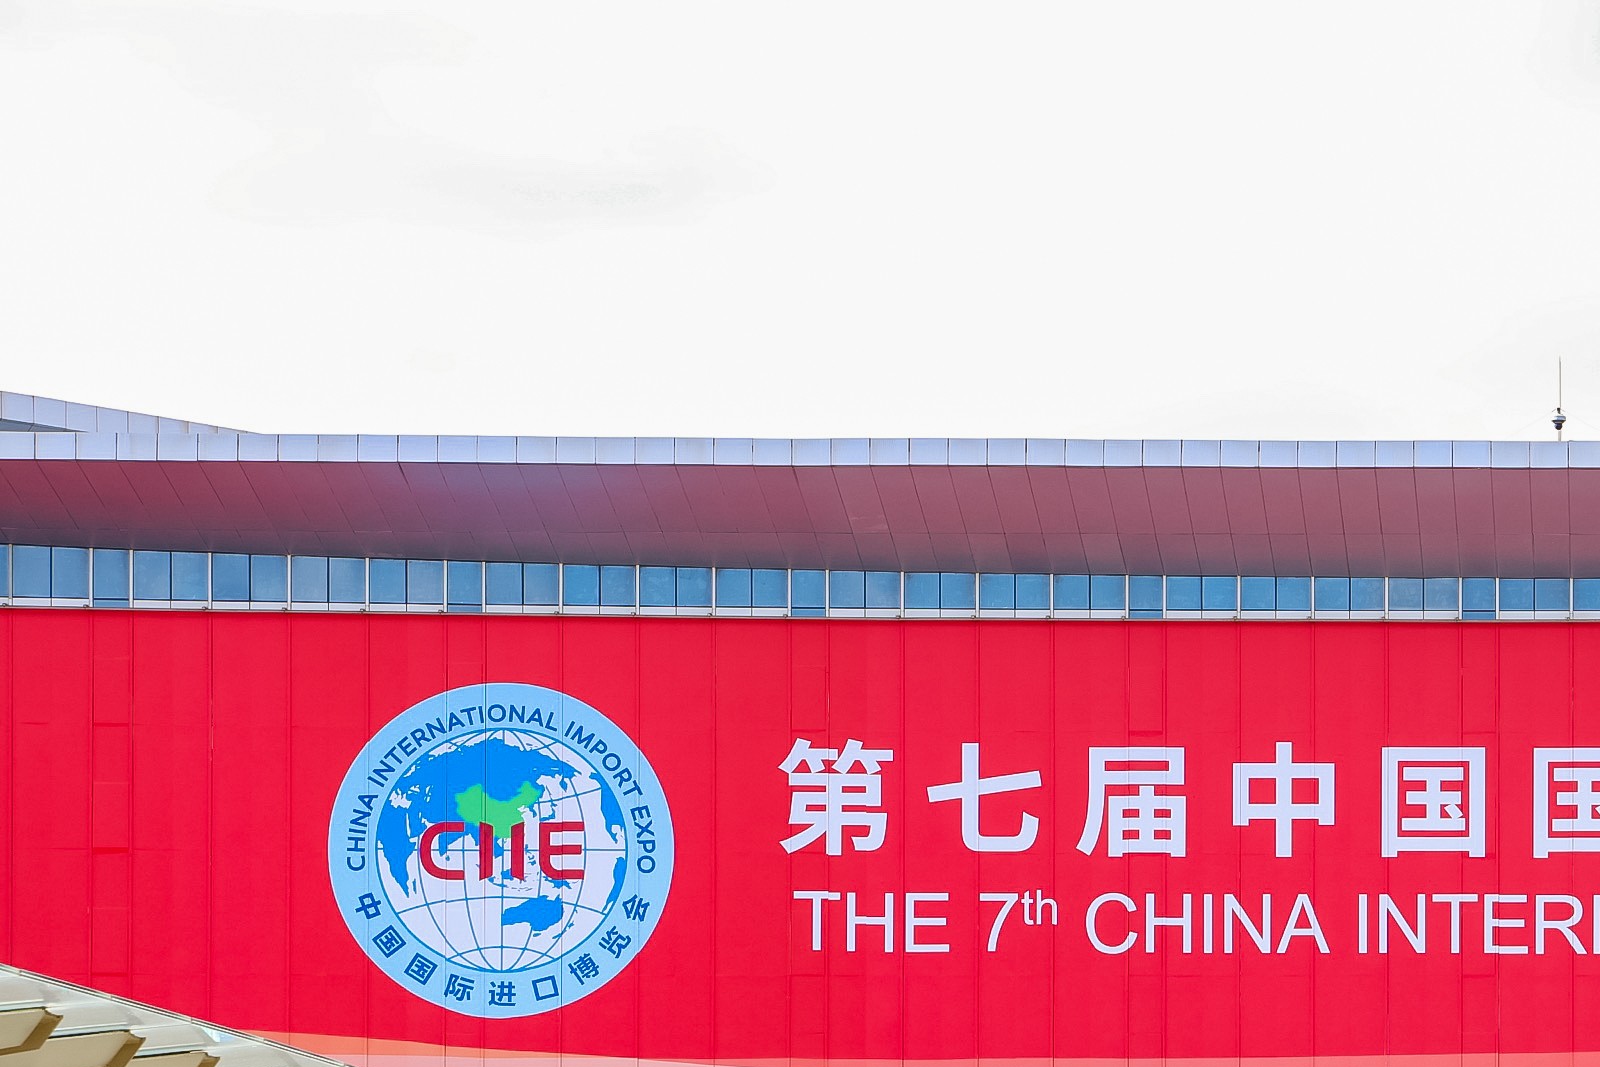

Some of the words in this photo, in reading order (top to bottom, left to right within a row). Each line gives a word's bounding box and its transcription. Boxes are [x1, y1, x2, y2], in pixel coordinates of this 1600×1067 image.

[346, 792, 379, 872] CHINA
[367, 703, 559, 788] INTERNATIONAL
[564, 720, 642, 797] IMPORT
[630, 805, 656, 874] EXPO
[419, 821, 585, 882] CIIE
[354, 892, 651, 1007] 中国国际进口博览会
[794, 891, 949, 952] THE
[980, 890, 1057, 951] 7th
[1086, 893, 1330, 954] CHINA
